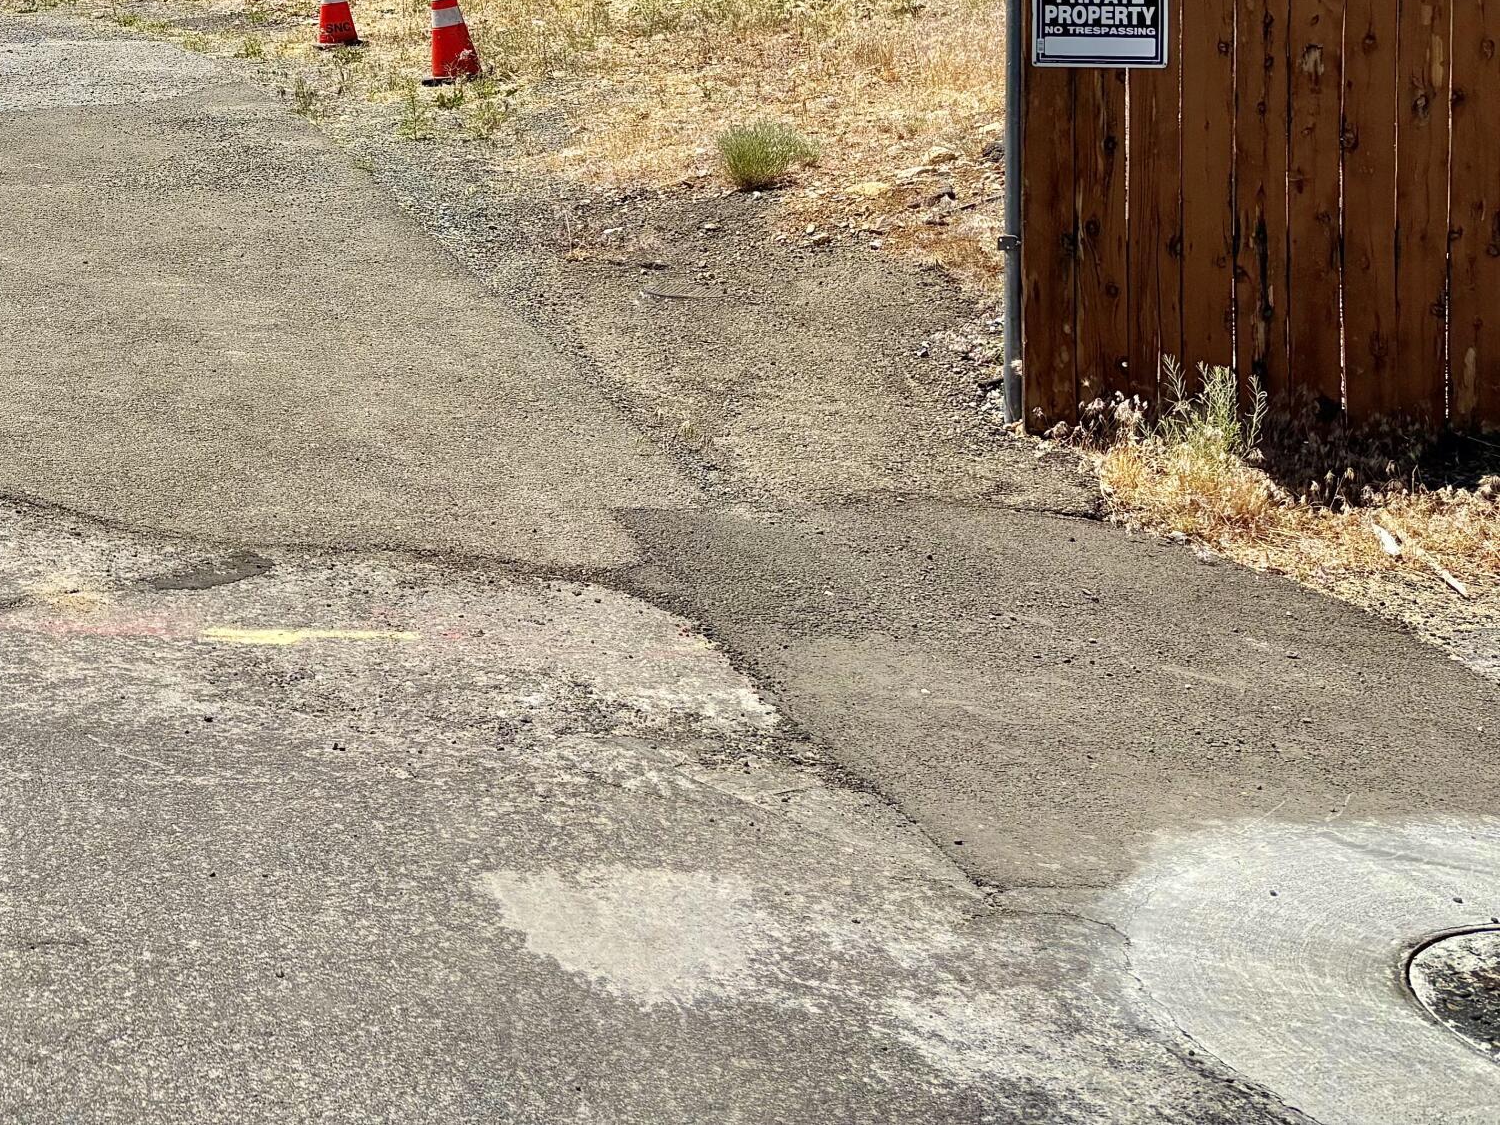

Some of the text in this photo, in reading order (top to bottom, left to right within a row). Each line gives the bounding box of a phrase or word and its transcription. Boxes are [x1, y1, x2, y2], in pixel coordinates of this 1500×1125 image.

[1044, 5, 1156, 25] PROPERTY
[1044, 25, 1156, 36] NO TRESPASSING
